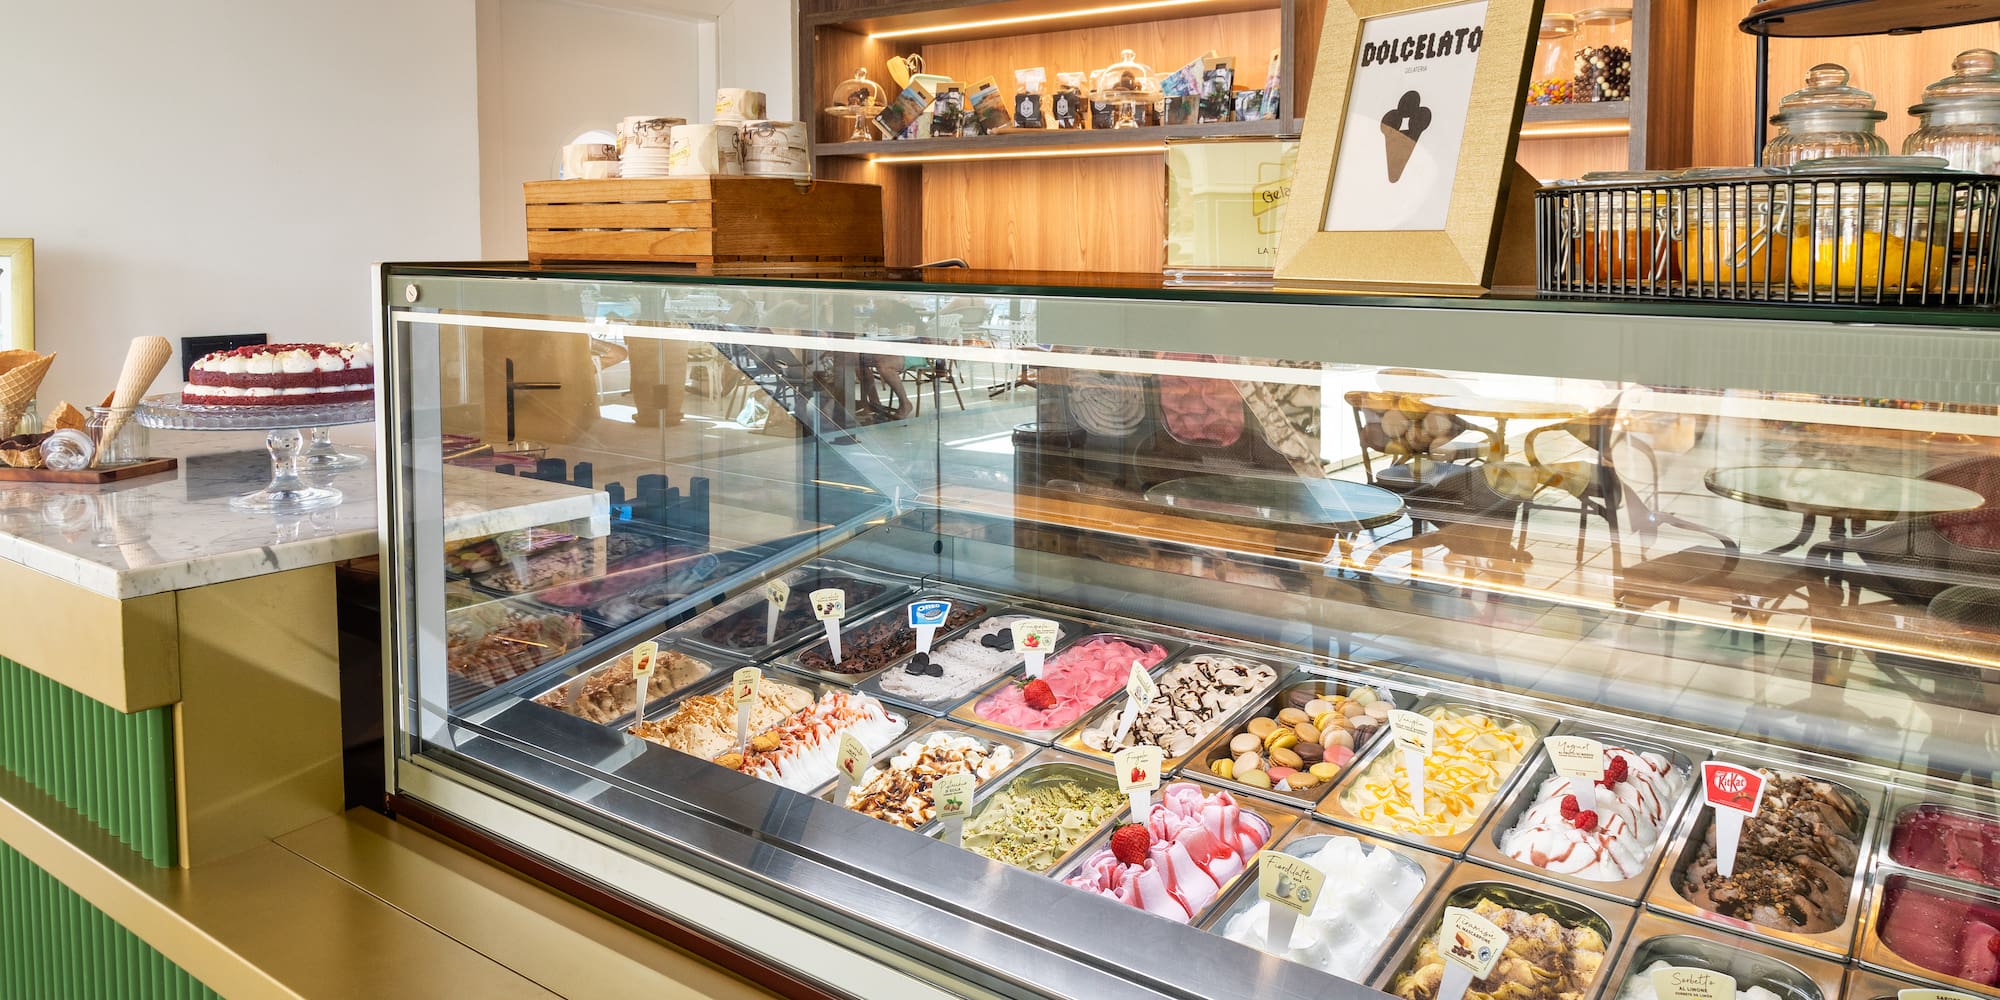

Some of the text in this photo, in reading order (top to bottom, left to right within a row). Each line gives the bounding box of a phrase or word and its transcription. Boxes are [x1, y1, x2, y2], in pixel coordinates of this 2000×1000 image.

[1361, 25, 1483, 67] DOLCELATO
[1257, 247, 1269, 255] LA
[1718, 772, 1745, 792] KitKat
